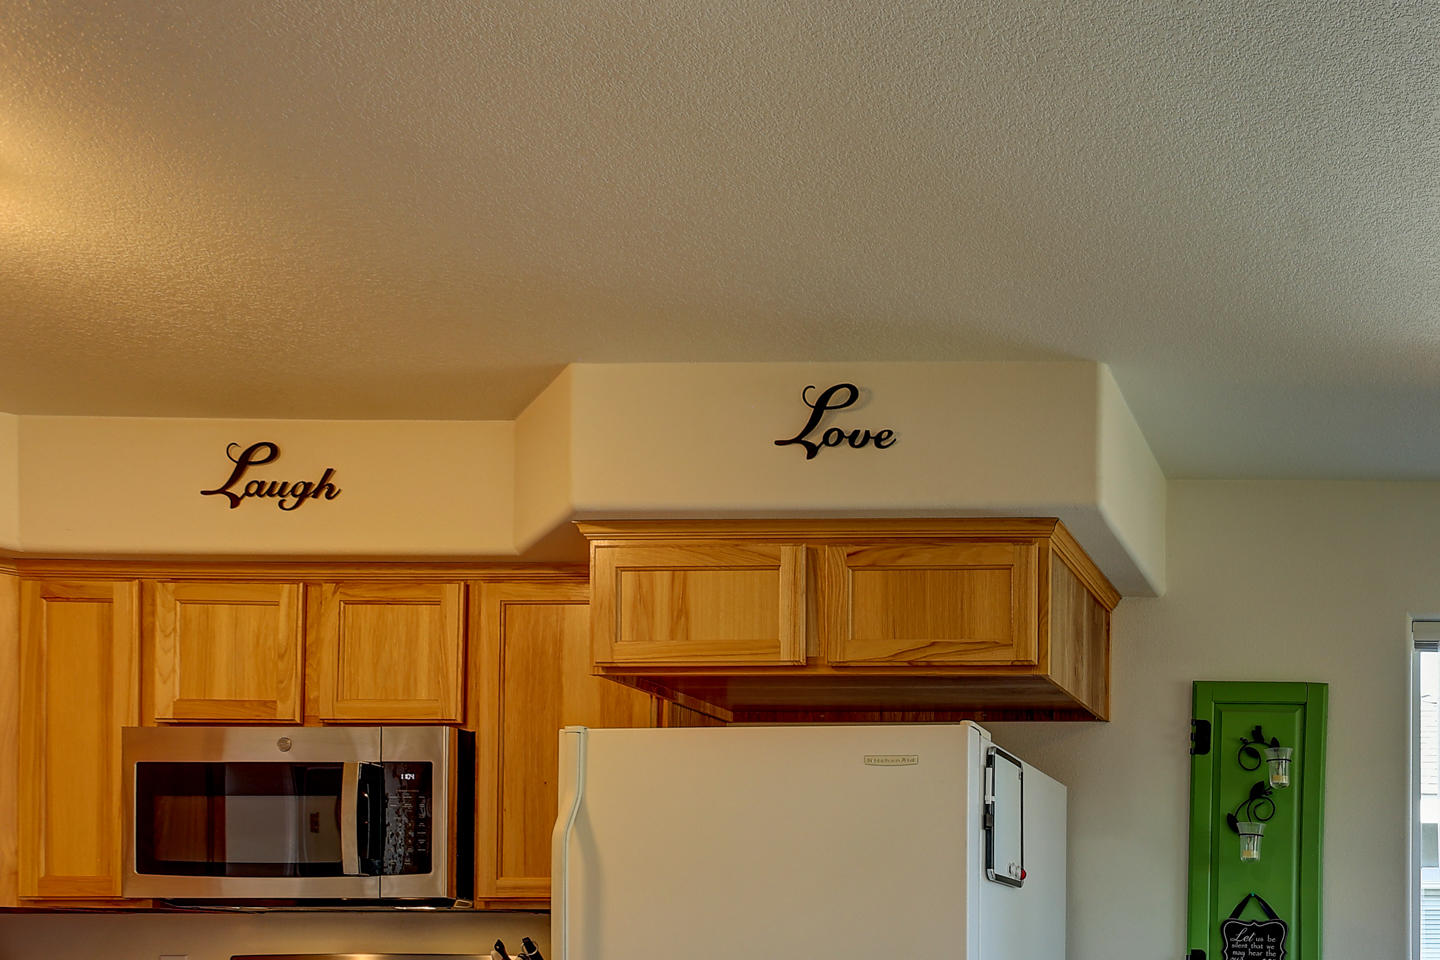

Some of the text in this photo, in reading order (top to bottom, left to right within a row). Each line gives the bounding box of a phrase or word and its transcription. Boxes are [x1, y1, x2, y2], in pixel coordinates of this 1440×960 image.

[775, 383, 897, 460] Love
[200, 441, 342, 511] Laugh
[1230, 927, 1255, 942] Let
[1267, 934, 1276, 942] be
[1232, 948, 1277, 958] may hear the
